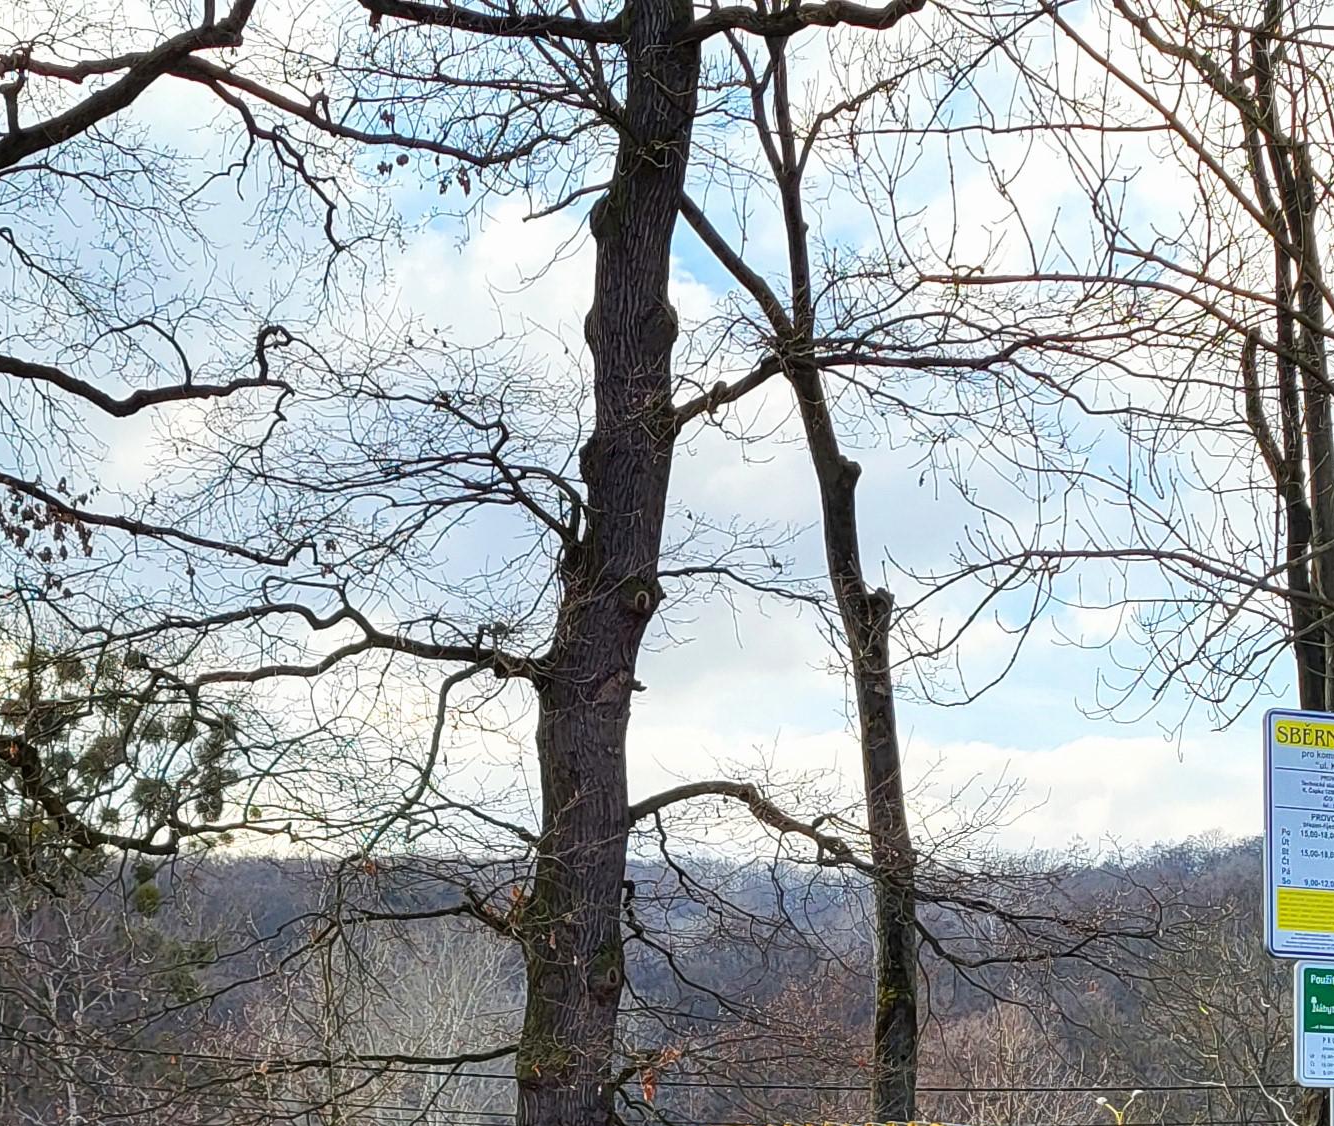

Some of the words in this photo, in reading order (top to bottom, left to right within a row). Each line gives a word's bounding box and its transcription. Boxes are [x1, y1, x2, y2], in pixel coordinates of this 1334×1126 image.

[1301, 751, 1314, 759] pro
[1282, 828, 1290, 836] Po
[1282, 867, 1290, 875] Pá
